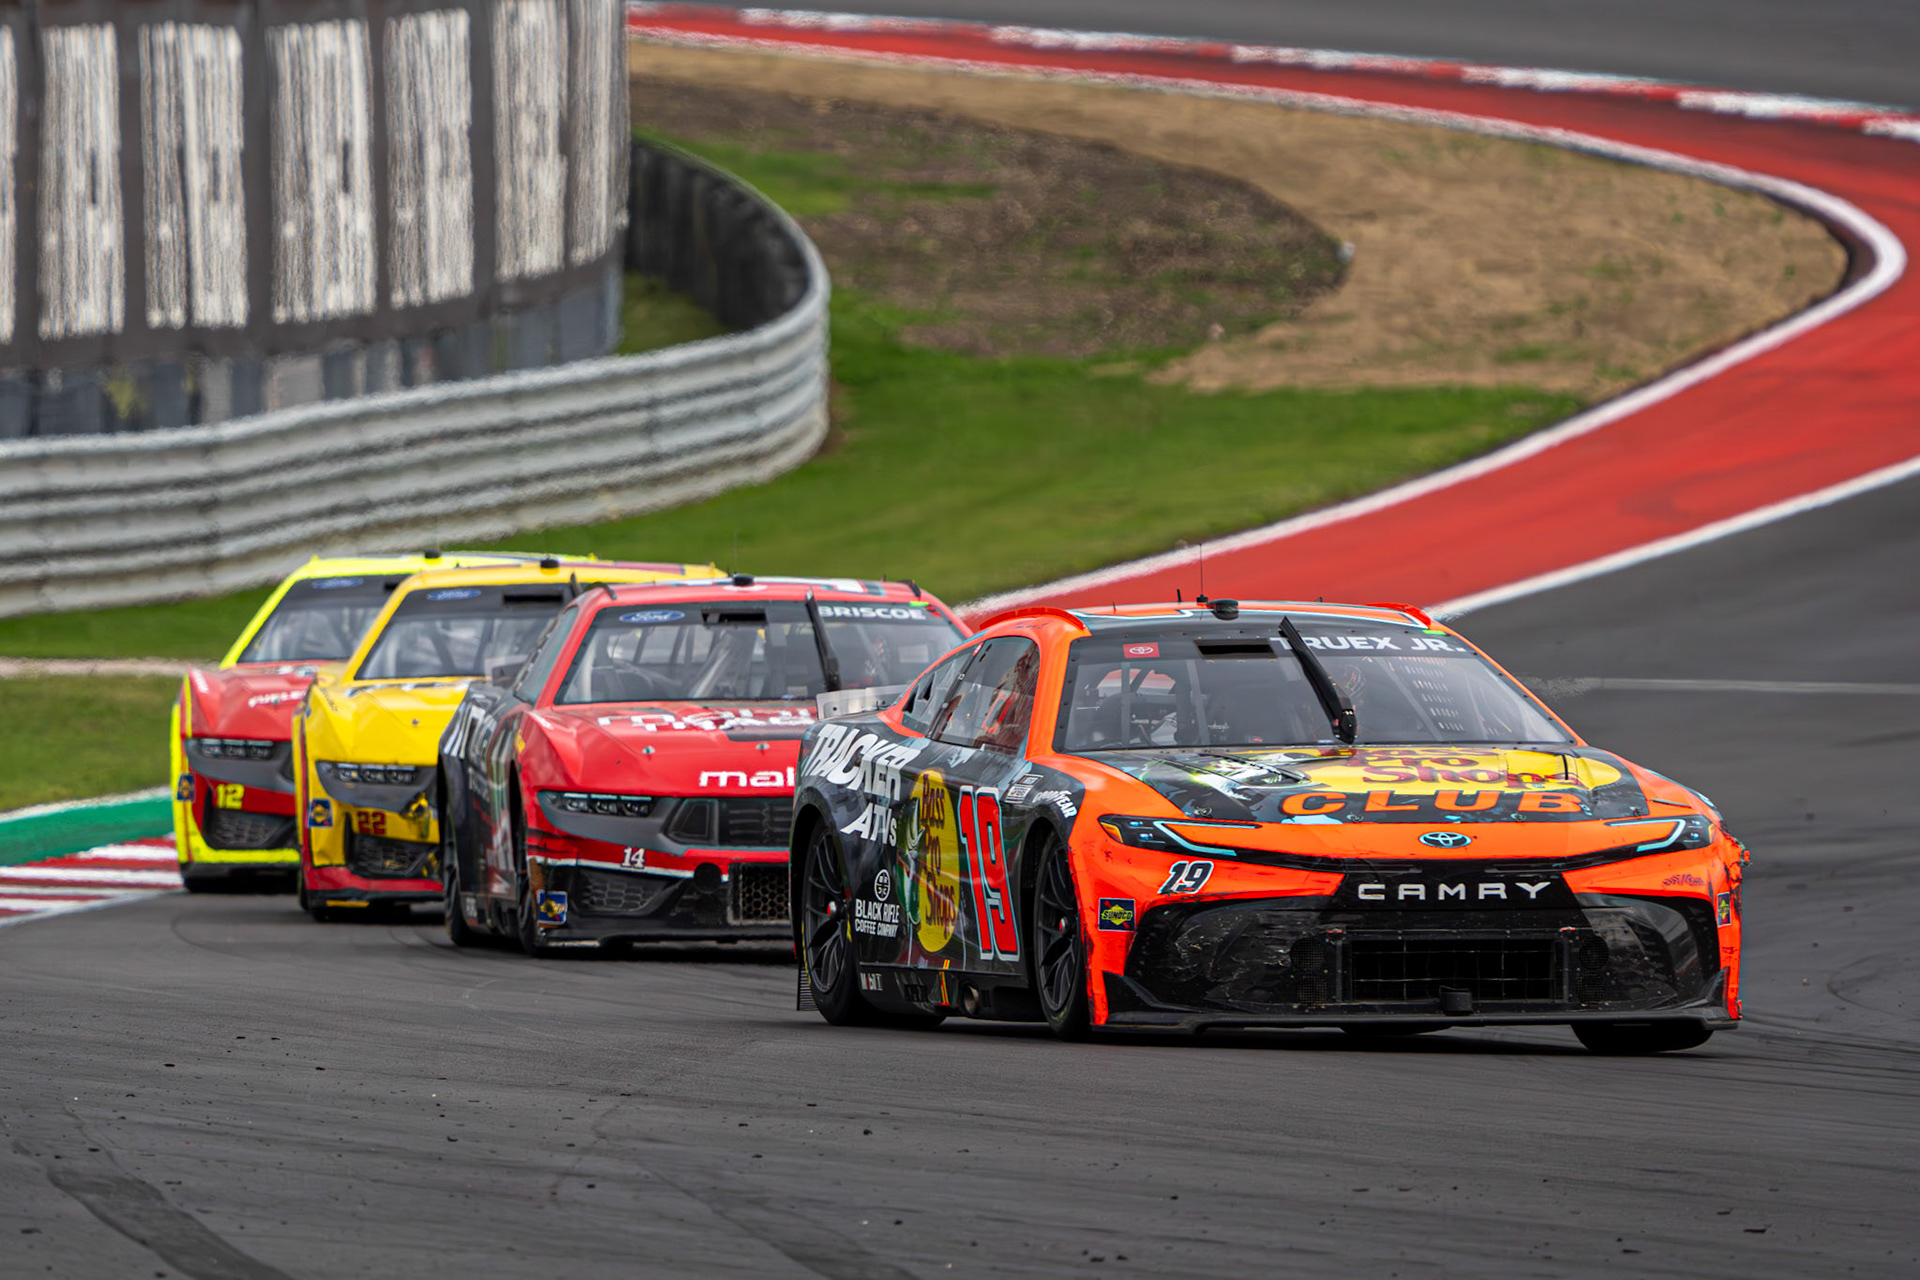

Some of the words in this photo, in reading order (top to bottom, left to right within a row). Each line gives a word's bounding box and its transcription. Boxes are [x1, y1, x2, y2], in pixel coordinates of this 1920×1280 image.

[819, 605, 928, 620] BRISCOE
[1270, 636, 1402, 650] TRUEX
[1411, 637, 1466, 652] JR.
[801, 724, 921, 801] TRACKER
[216, 784, 246, 809] 12
[921, 774, 946, 829] Bass
[1281, 790, 1583, 815] CLUB
[357, 811, 386, 835] 22
[840, 803, 897, 847] ATVs
[621, 847, 646, 869] 14
[923, 822, 942, 877] Pro
[957, 785, 1020, 962] 19
[1157, 861, 1214, 895] 19
[1358, 882, 1552, 900] CAMRY
[855, 898, 882, 920] BLACK
[883, 903, 900, 923] RIFLE
[924, 871, 957, 940] Shops
[1102, 909, 1133, 920] SUNOCO
[855, 918, 876, 935] COFFEE
[877, 922, 899, 938] COMPANY
